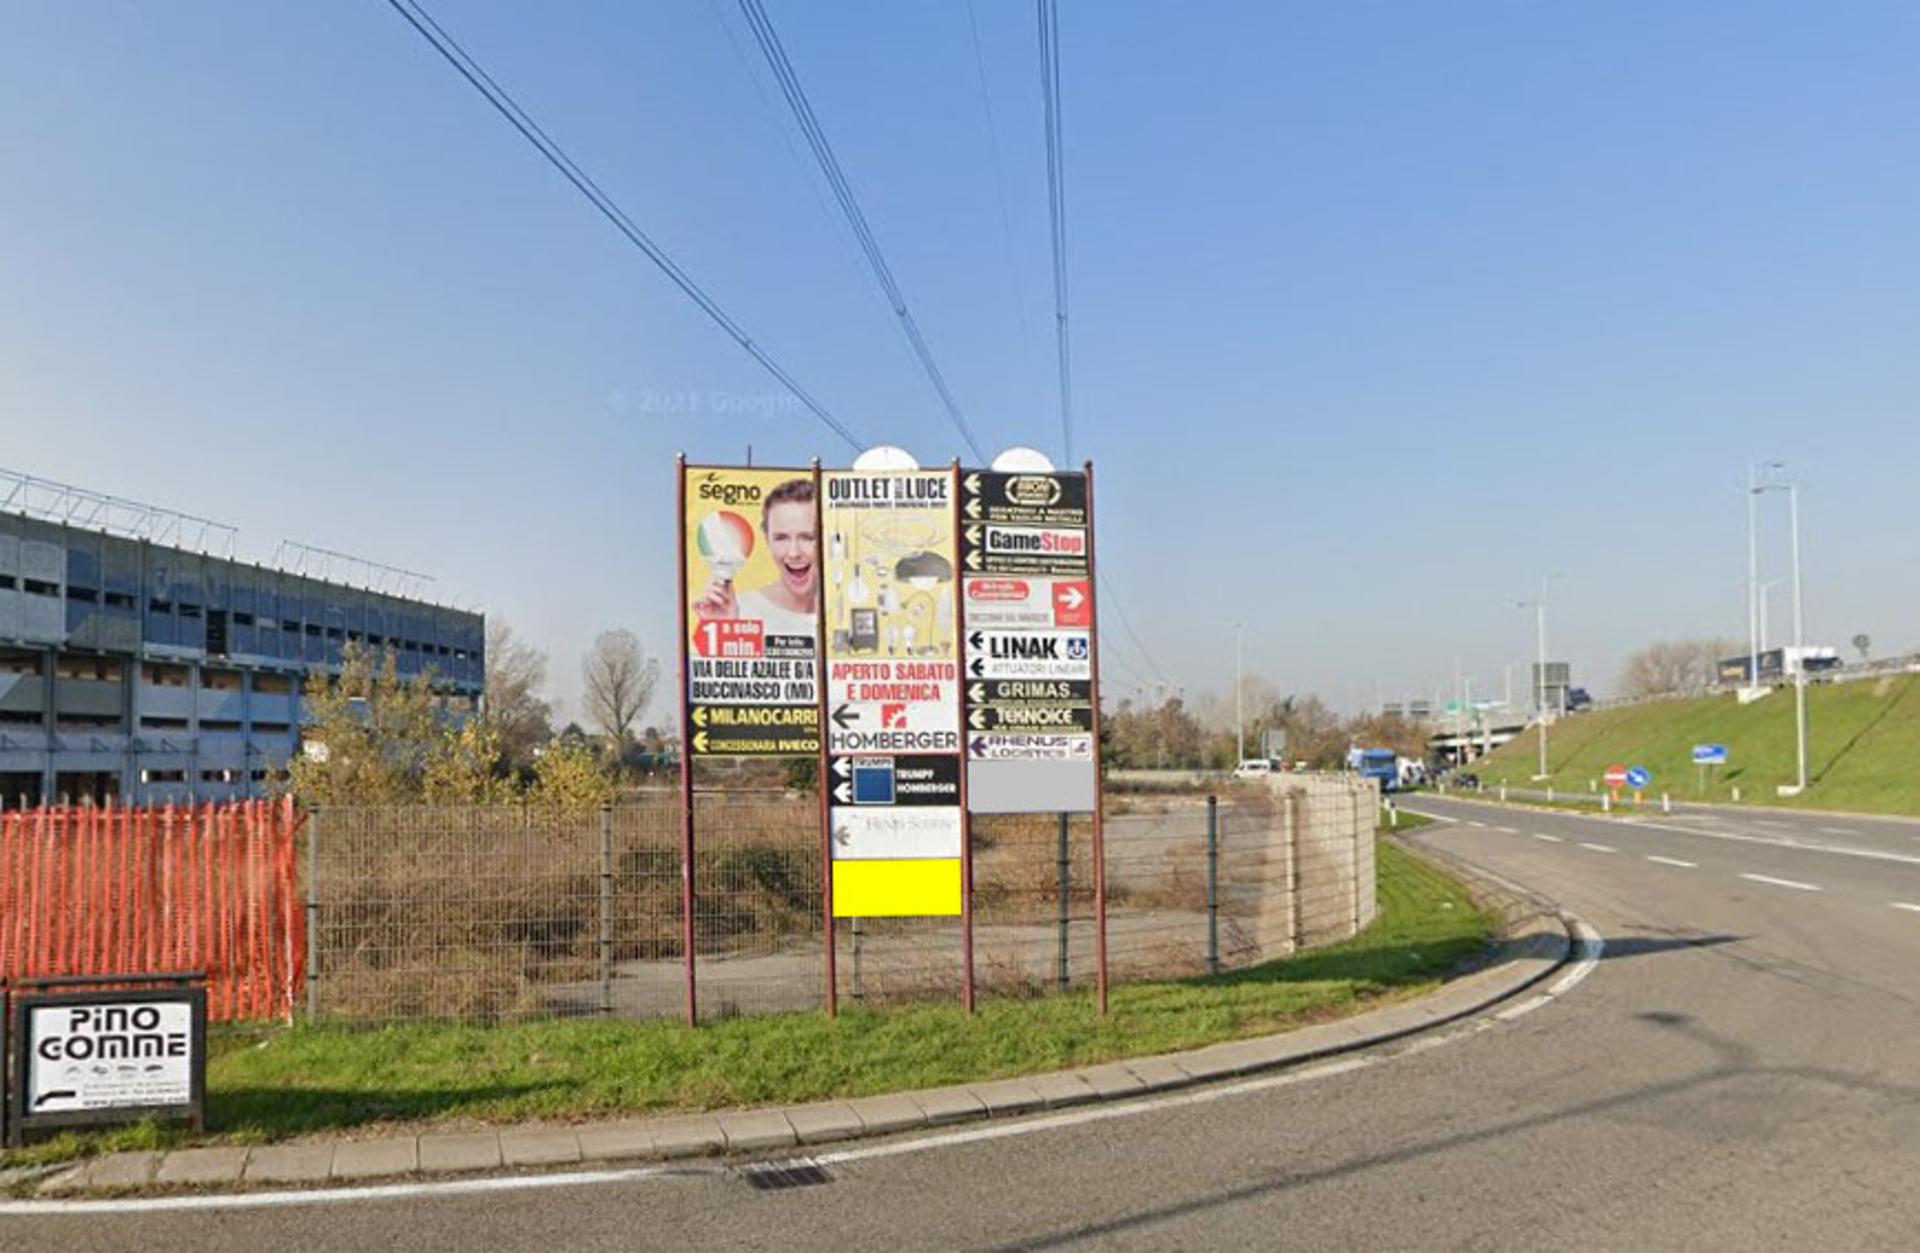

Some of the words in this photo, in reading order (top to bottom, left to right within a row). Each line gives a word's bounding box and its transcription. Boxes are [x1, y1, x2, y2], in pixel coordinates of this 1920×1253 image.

[699, 483, 761, 505] segno
[829, 478, 890, 499] OUTLET
[906, 478, 948, 499] LUCE
[989, 530, 1082, 552] GameStop
[734, 622, 760, 634] solo
[703, 622, 717, 656] 1
[723, 637, 761, 656] min.
[990, 637, 1059, 659] LINAK
[693, 660, 713, 678] VIA
[715, 660, 748, 678] DELLE
[751, 661, 791, 679] AZALEE
[832, 663, 891, 680] APERTO
[895, 663, 955, 681] SABATO
[693, 681, 780, 700] BUCCINASCO
[847, 684, 856, 700] E
[860, 684, 941, 701] DOMENICA
[997, 682, 1071, 698] GRIMAS
[710, 708, 818, 724] MILANOCARRI
[779, 740, 819, 751] IVECO
[832, 732, 957, 749] HOMBERGER
[988, 736, 1069, 747] RHENUS
[992, 748, 1066, 758] LOGISTICS
[897, 783, 957, 793] HOMBERGER
[38, 1033, 187, 1061] GOMME
